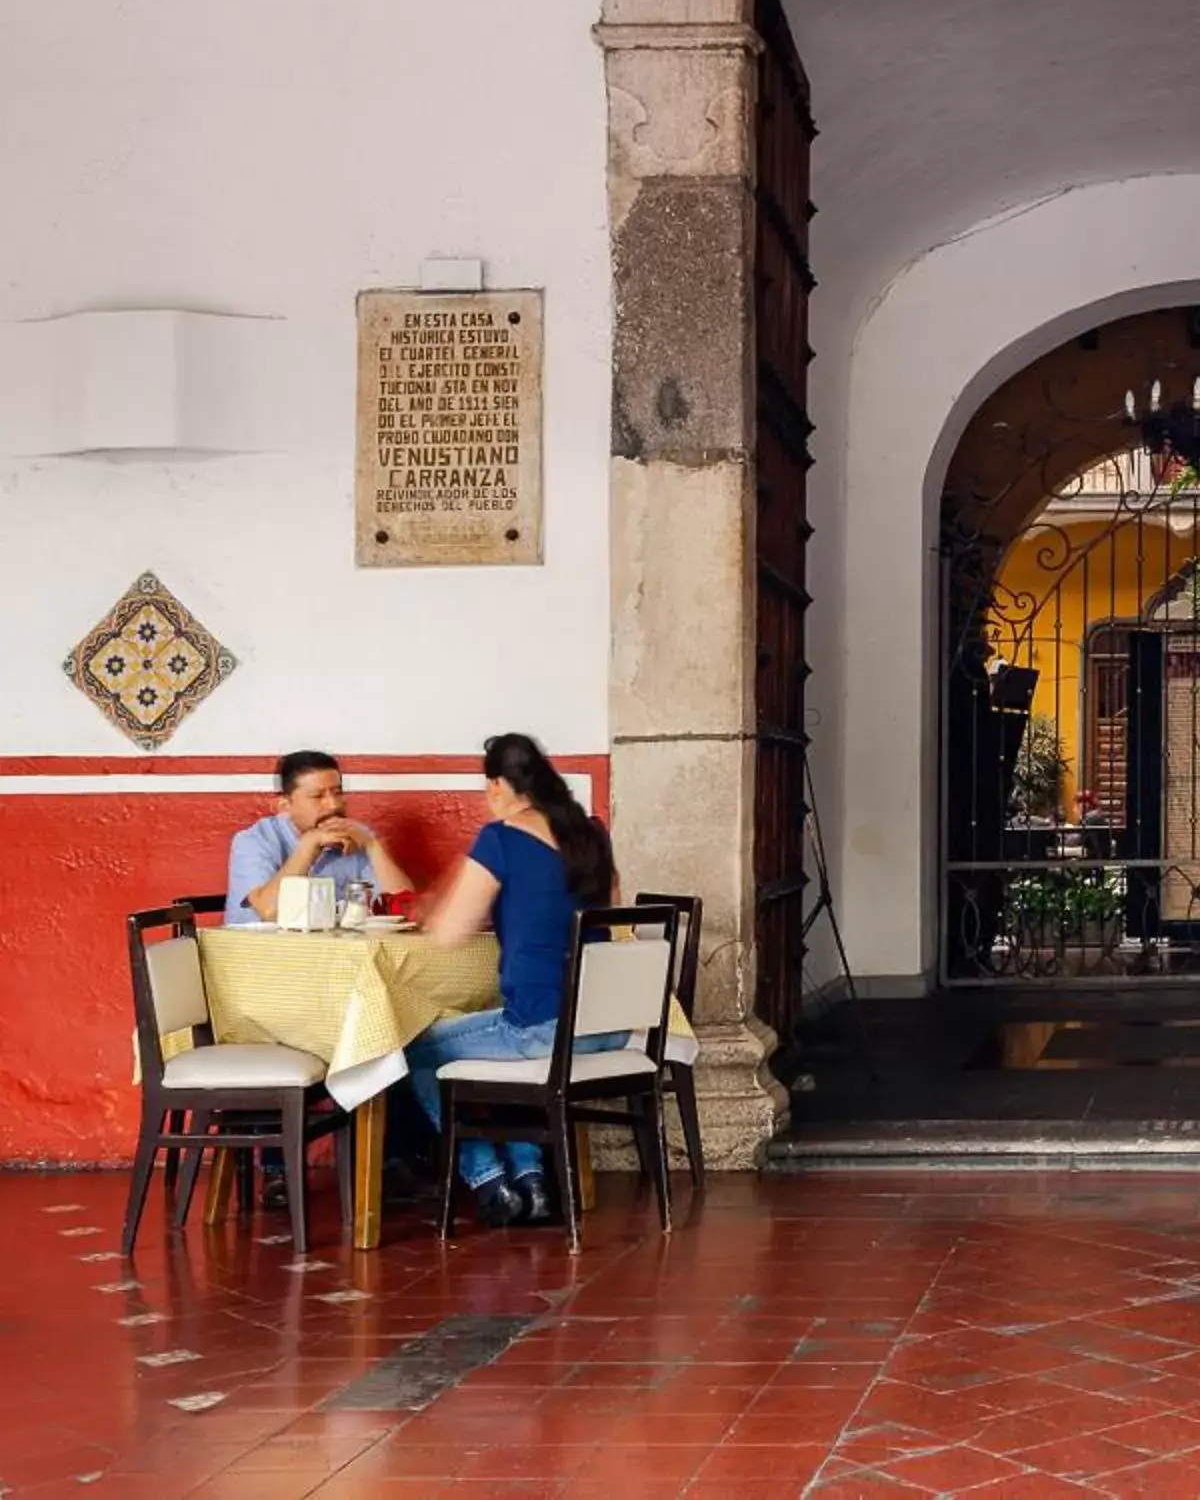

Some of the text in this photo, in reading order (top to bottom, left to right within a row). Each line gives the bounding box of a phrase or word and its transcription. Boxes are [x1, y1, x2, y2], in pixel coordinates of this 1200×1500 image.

[405, 312, 494, 328] EN ESTA CASA
[459, 329, 510, 344] ESTUVO
[409, 363, 471, 378] EJERCITO
[472, 380, 488, 394] EN
[379, 397, 403, 412] DEL
[438, 397, 454, 410] DE
[493, 396, 519, 410] SIEN
[378, 414, 394, 429] DO
[400, 414, 416, 428] EL
[503, 412, 518, 426] EL
[423, 430, 492, 444] CIUDADANO
[496, 429, 519, 443] DON
[379, 446, 519, 466] VENUSTIANO
[389, 468, 506, 488] CARRANZA
[473, 488, 489, 499] DE
[492, 487, 517, 499] LOS
